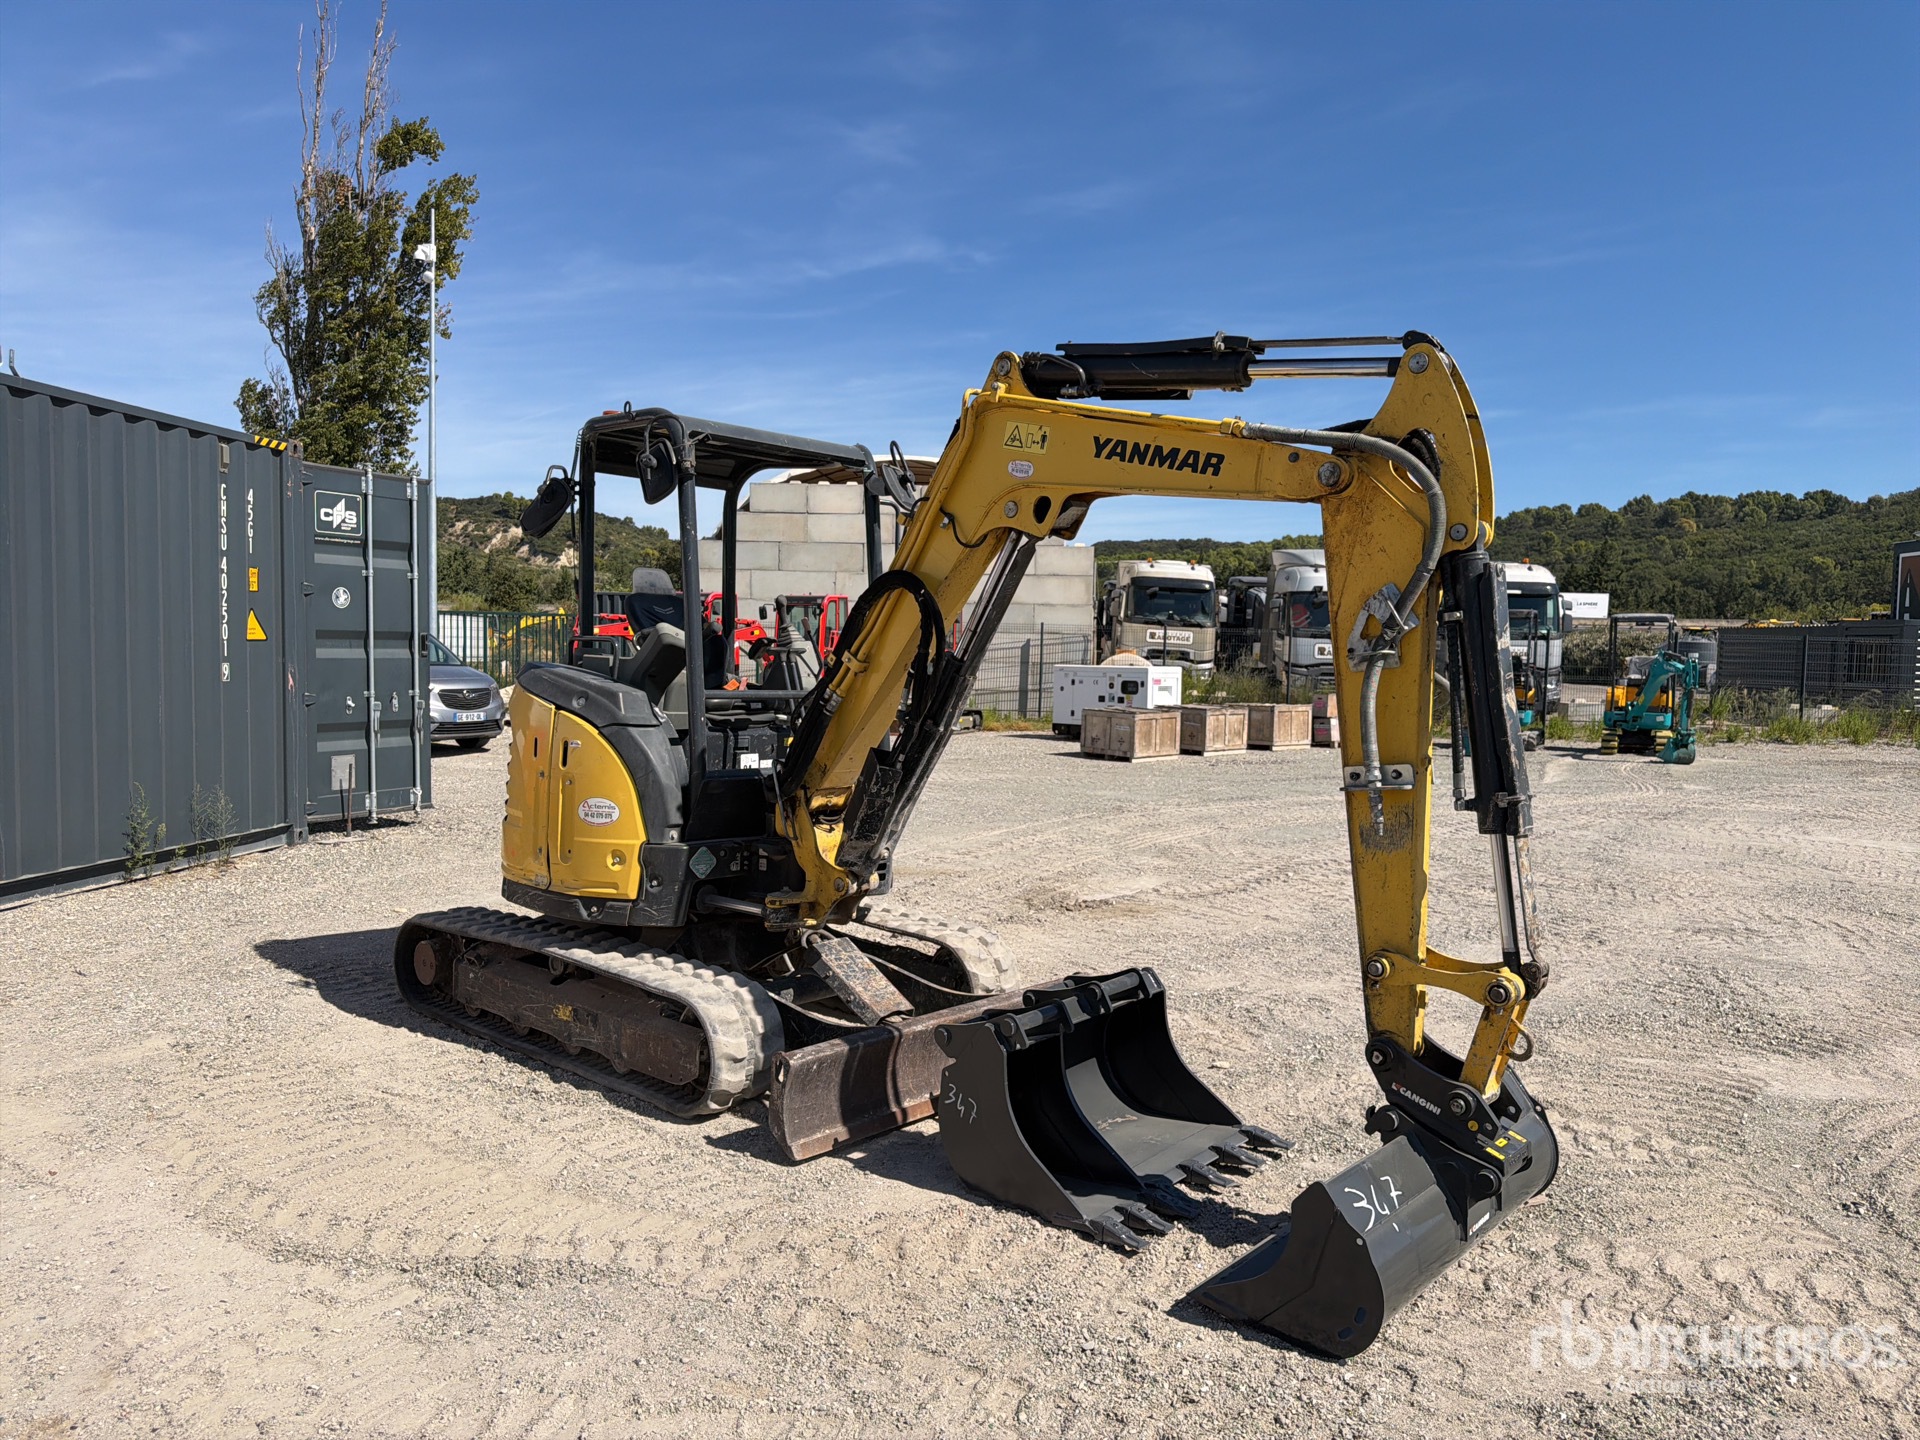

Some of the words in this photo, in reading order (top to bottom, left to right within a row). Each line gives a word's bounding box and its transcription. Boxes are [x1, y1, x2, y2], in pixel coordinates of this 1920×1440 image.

[1093, 436, 1226, 477] YANMAR
[220, 483, 228, 551] CHSU
[220, 556, 229, 657] 402501
[222, 663, 230, 681] 9
[944, 1083, 977, 1124] 347
[1344, 1175, 1403, 1232] 347
